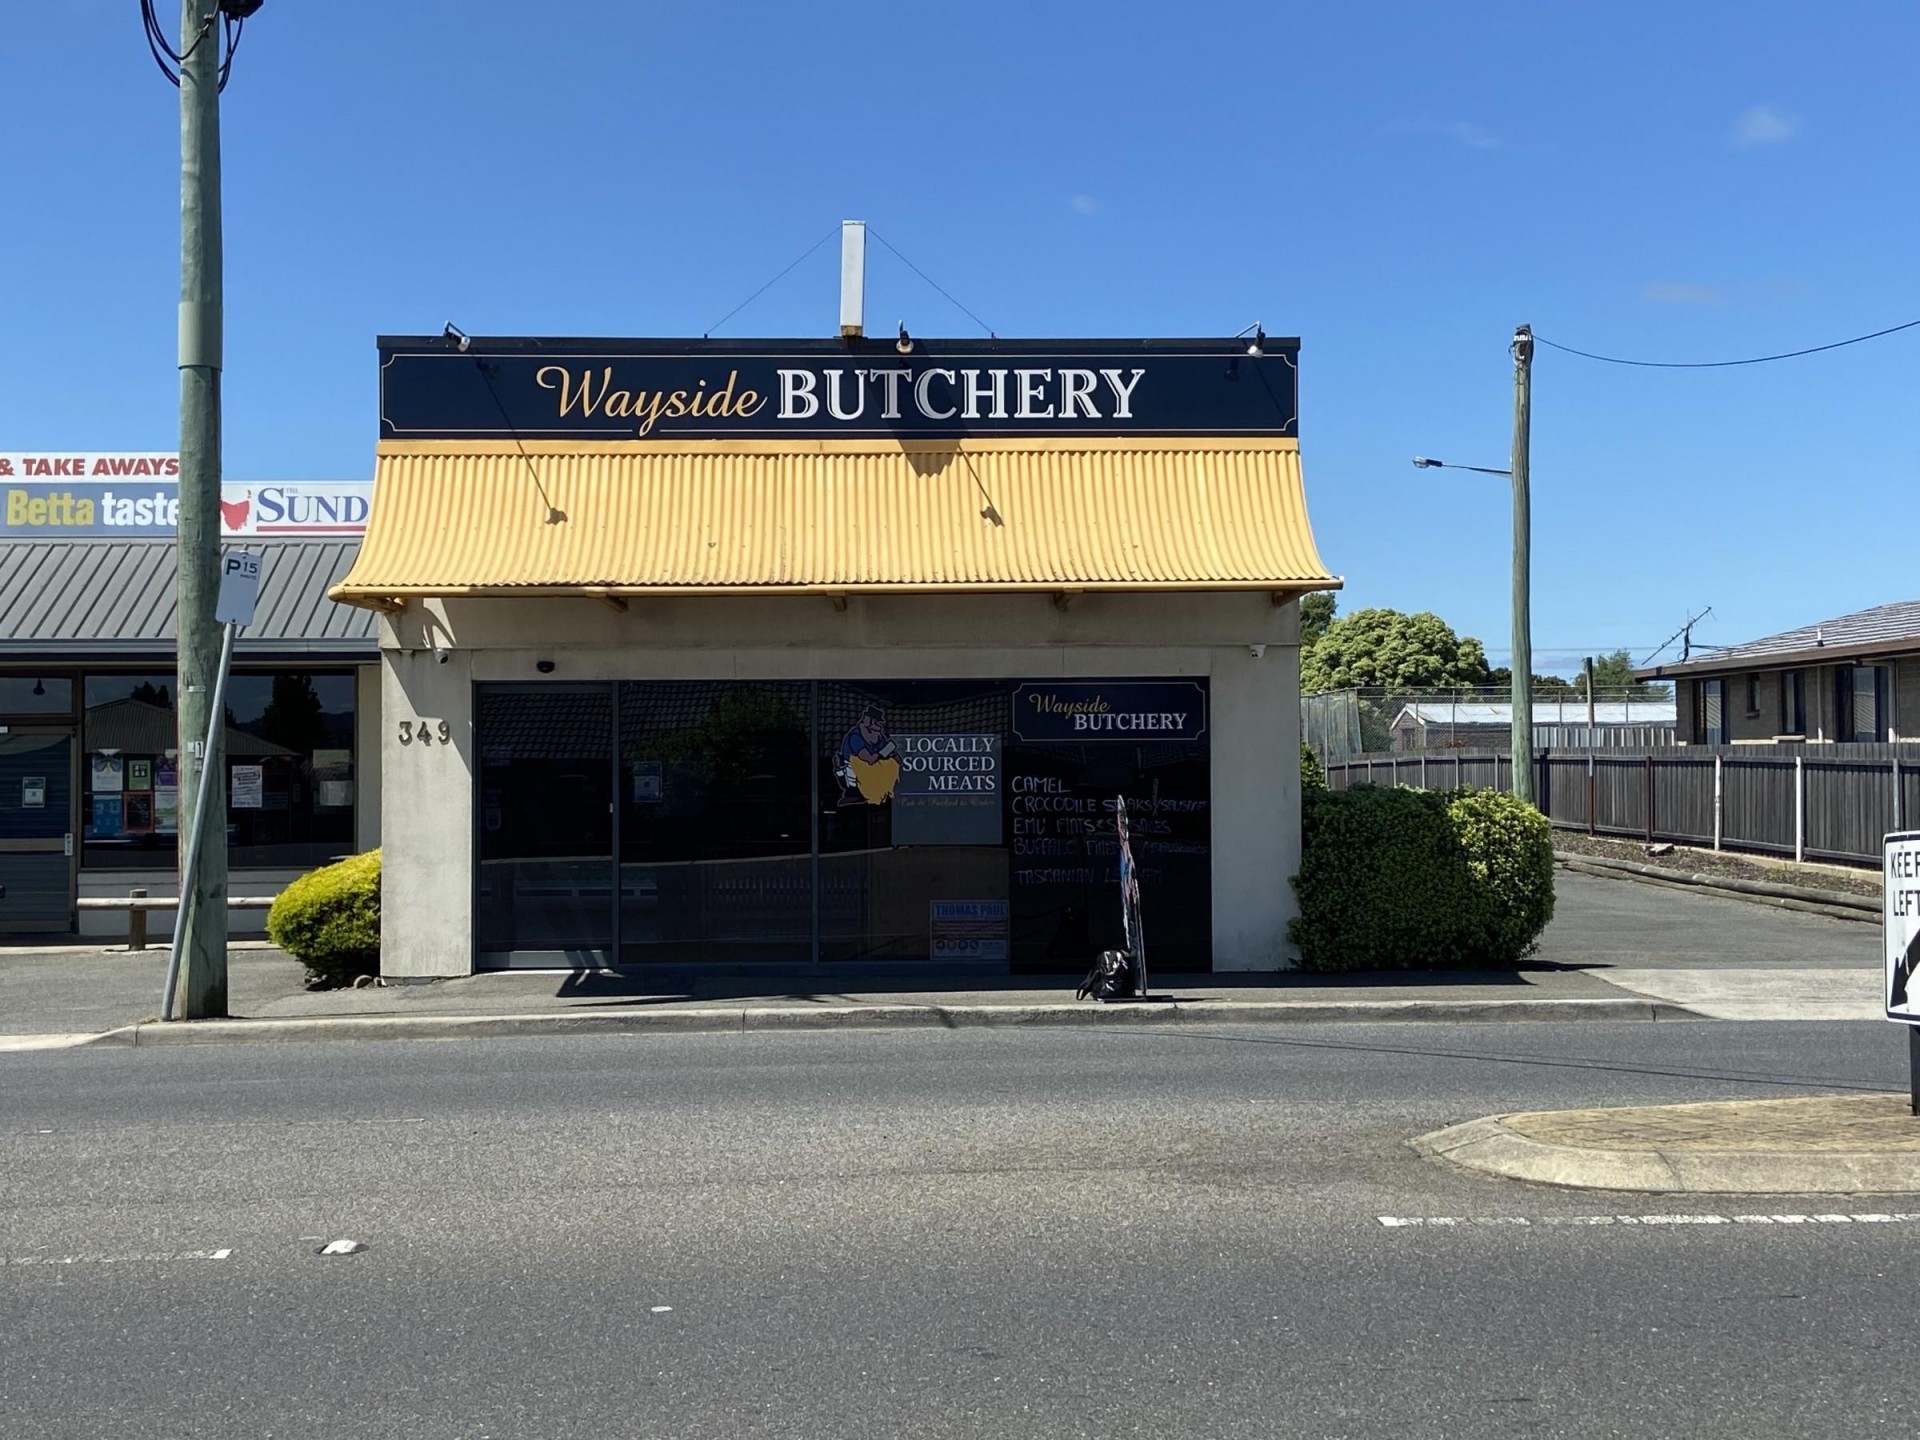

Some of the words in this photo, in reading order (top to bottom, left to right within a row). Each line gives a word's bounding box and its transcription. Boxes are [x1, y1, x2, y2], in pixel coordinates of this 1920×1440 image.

[536, 366, 768, 437] Wayside
[777, 368, 1146, 420] BUTCHERY
[23, 458, 85, 476] TAKE
[92, 458, 179, 476] AWAYS
[7, 489, 95, 526] Betta
[256, 487, 370, 523] SUND
[1029, 694, 1110, 719] Wayside
[1074, 713, 1187, 730] BUTCHERY
[398, 720, 450, 747] 349
[905, 737, 995, 753] LOCALLY
[903, 756, 995, 772] SOURCED
[928, 775, 995, 791] MEATS
[1012, 775, 1072, 793] CAMEL
[1012, 796, 1097, 814] CROCODILE
[1013, 817, 1046, 835] EMU
[1013, 867, 1094, 885] TASMANIAN
